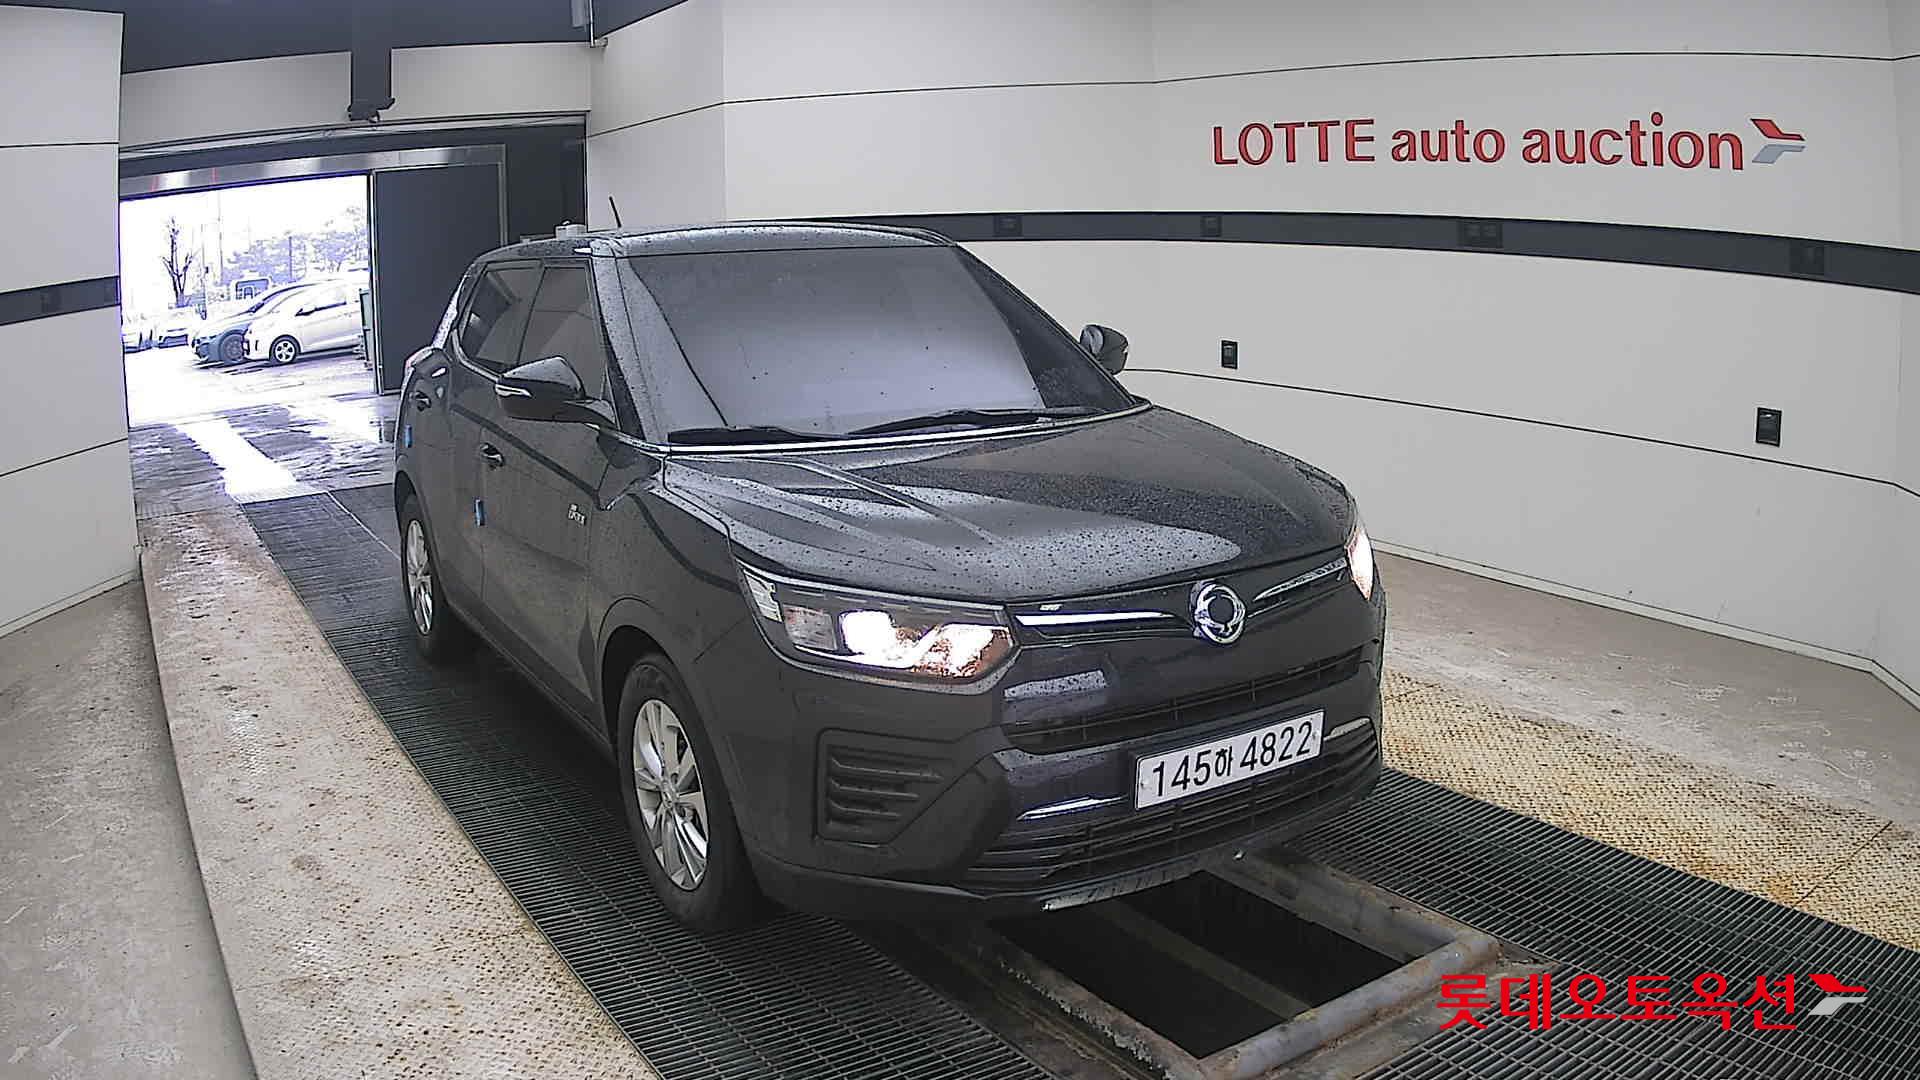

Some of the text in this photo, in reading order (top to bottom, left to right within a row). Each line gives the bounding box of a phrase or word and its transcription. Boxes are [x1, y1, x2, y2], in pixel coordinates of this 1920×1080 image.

[1213, 112, 1744, 171] LOTTE auto auction
[1152, 720, 1313, 797] 145하 4822
